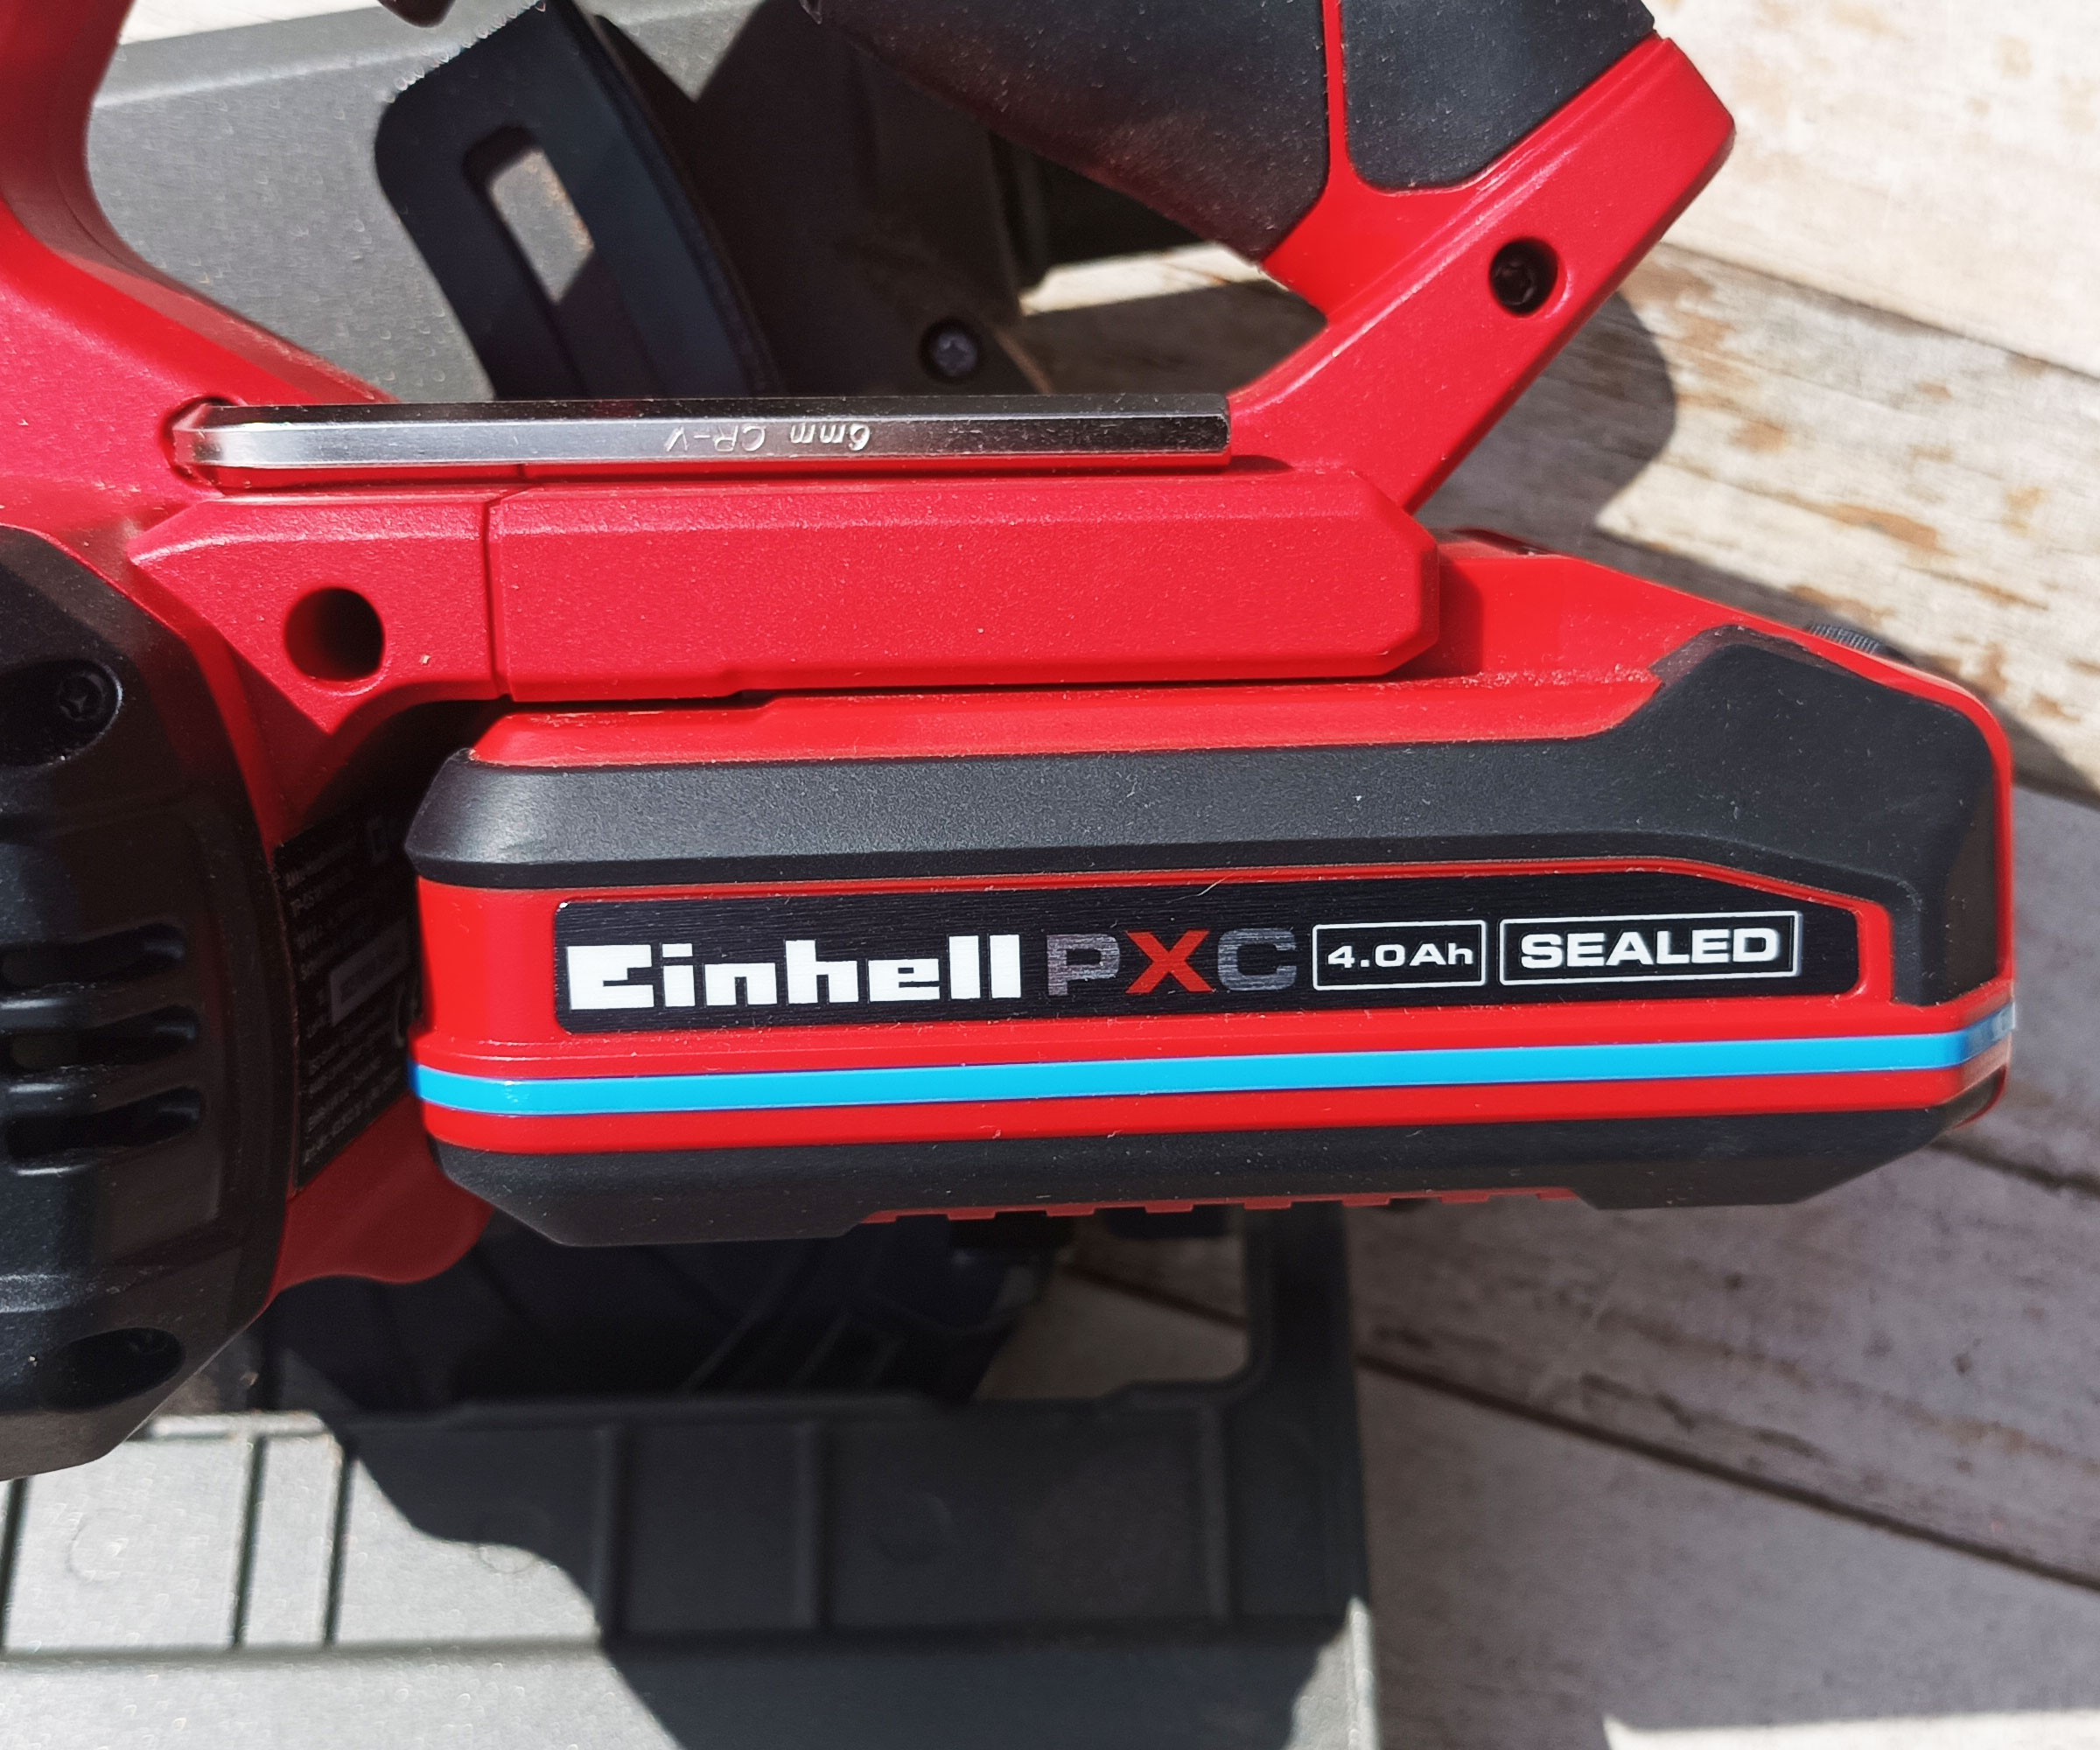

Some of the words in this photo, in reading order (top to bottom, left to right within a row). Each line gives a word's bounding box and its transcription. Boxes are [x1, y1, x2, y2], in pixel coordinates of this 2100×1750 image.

[664, 424, 766, 452] CR-V
[790, 423, 872, 452] 6mm
[566, 934, 1022, 1011] Einhell
[1046, 928, 1297, 996] PXC
[1327, 942, 1474, 969] 4.0Ah
[1521, 928, 1780, 969] SEALED
